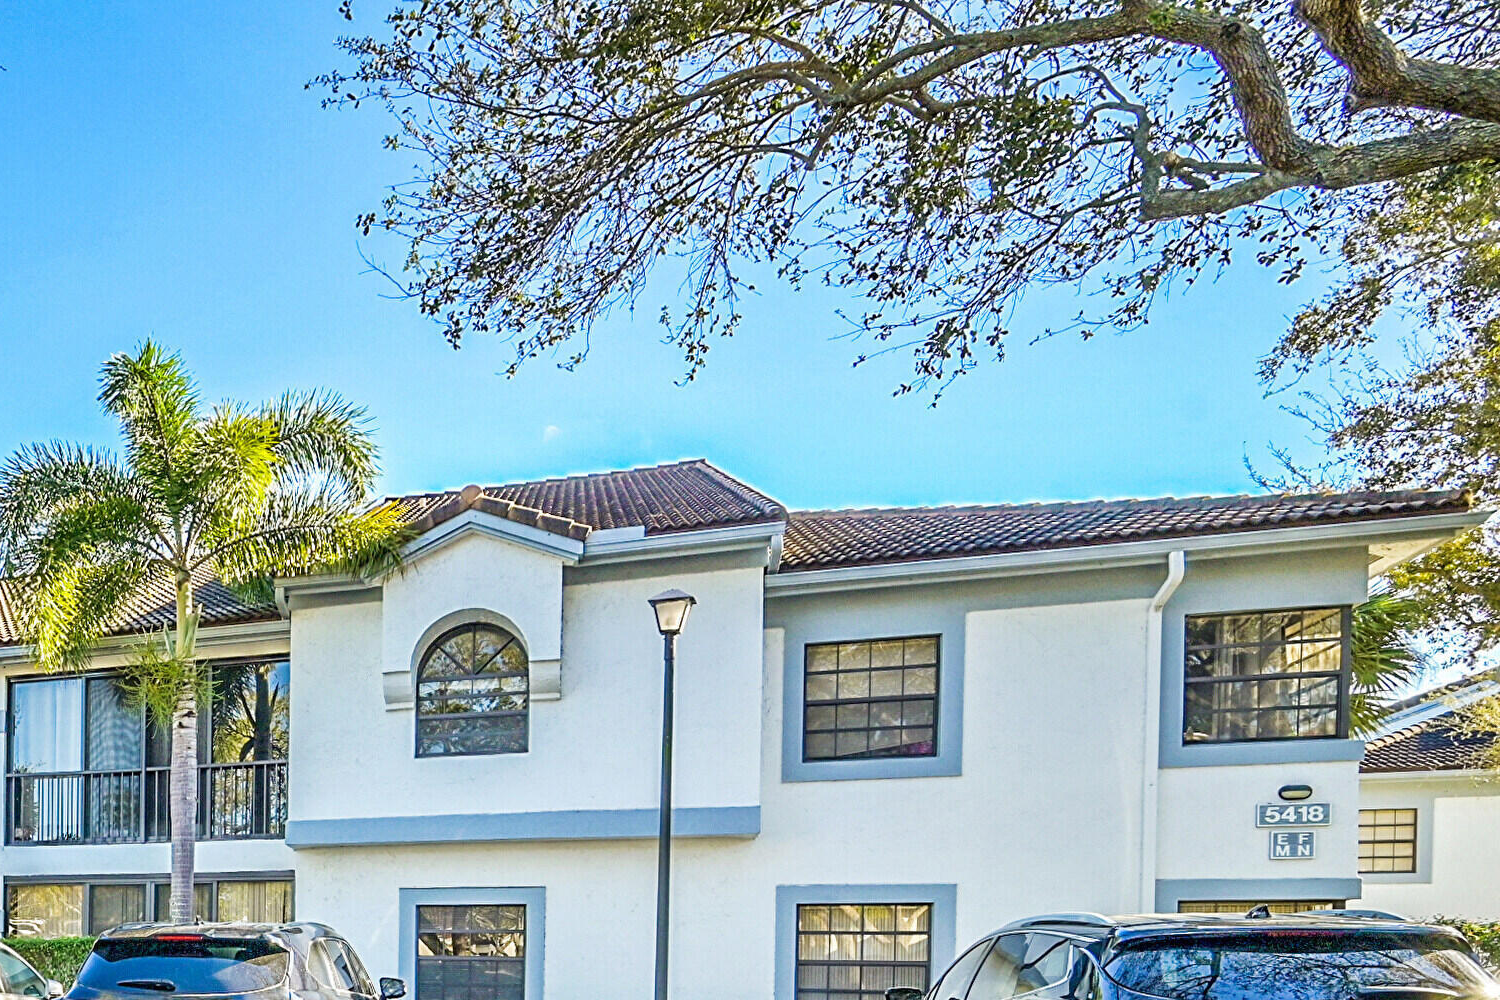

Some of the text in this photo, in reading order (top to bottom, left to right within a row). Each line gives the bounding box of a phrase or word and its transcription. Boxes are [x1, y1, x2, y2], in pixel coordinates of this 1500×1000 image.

[1264, 805, 1324, 823] 5418
[1277, 833, 1310, 845] E F
[1275, 844, 1310, 857] M N
